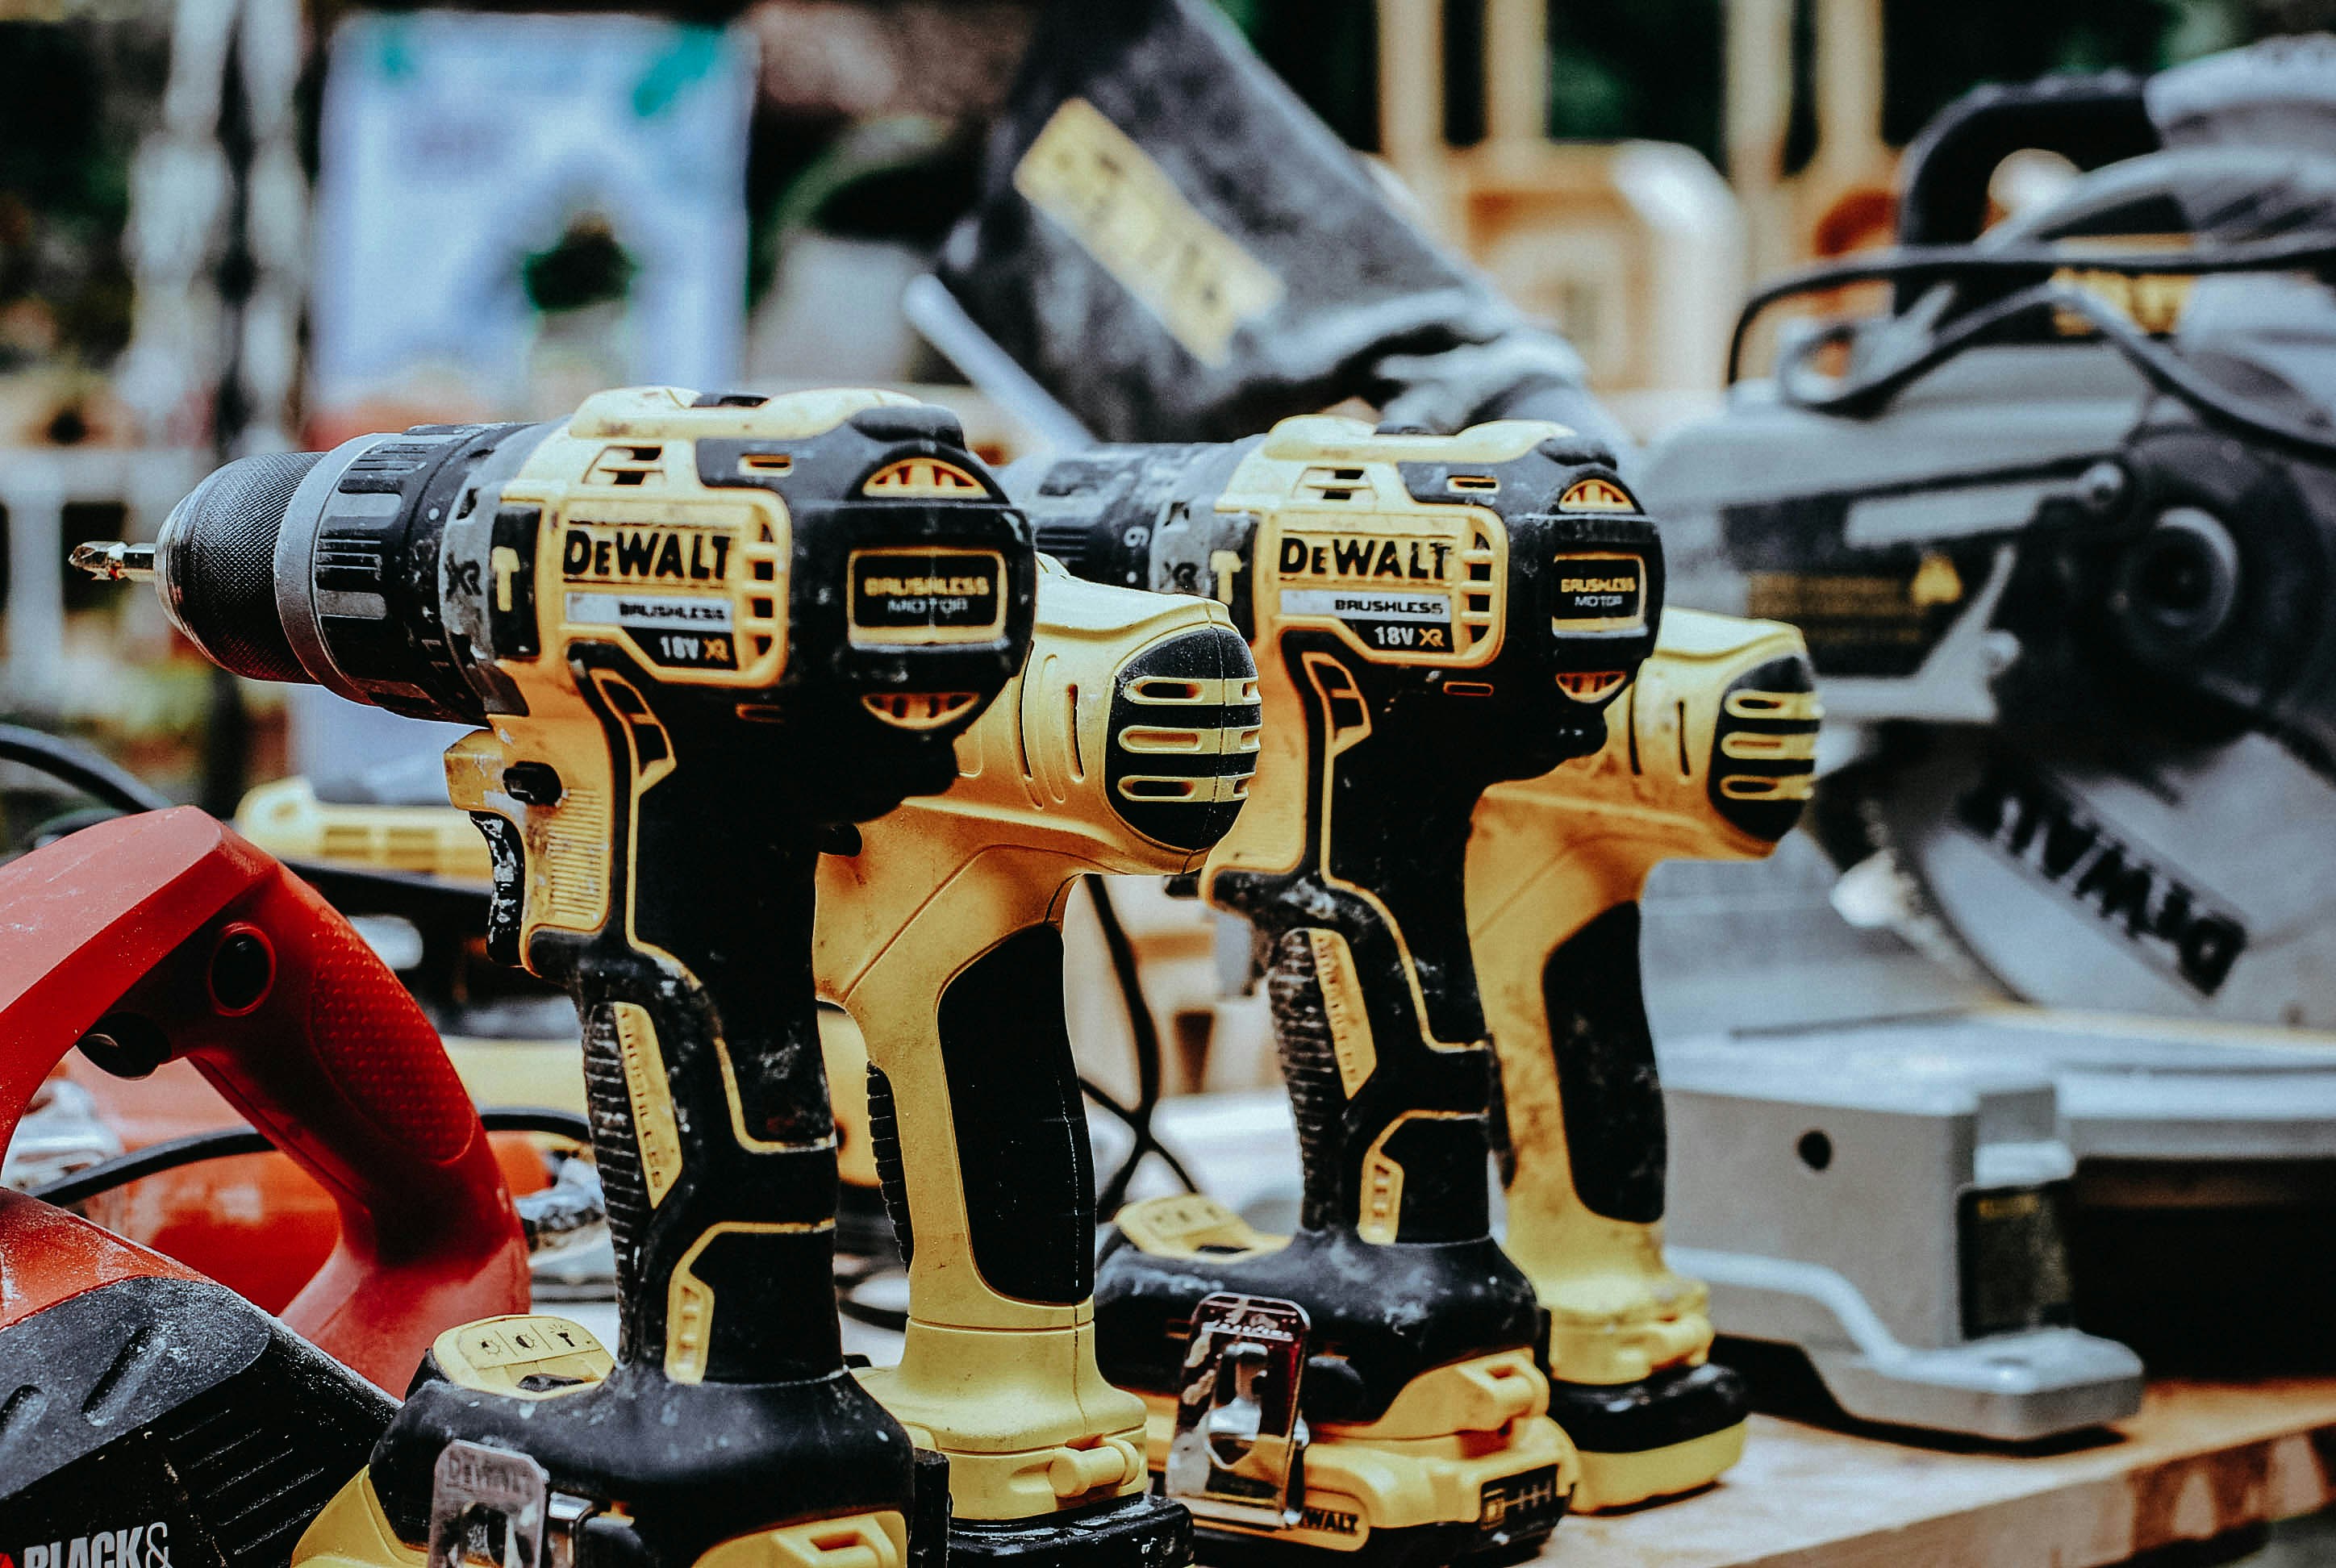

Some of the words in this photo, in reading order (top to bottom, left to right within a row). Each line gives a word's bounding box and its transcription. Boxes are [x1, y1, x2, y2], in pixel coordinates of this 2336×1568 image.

[563, 529, 731, 580] DEWALT
[1279, 538, 1451, 579] DEWALT
[865, 577, 990, 595] BRUSHLESS
[1561, 578, 1636, 592] BRUSHLESS
[888, 598, 968, 614] MOTOR
[1335, 598, 1443, 615] BRUSHLESS
[1575, 595, 1623, 607] MOTOR
[1374, 626, 1414, 645] 18V
[1419, 628, 1445, 647] XR
[703, 638, 730, 661] XR
[1299, 1508, 1359, 1533] WALT
